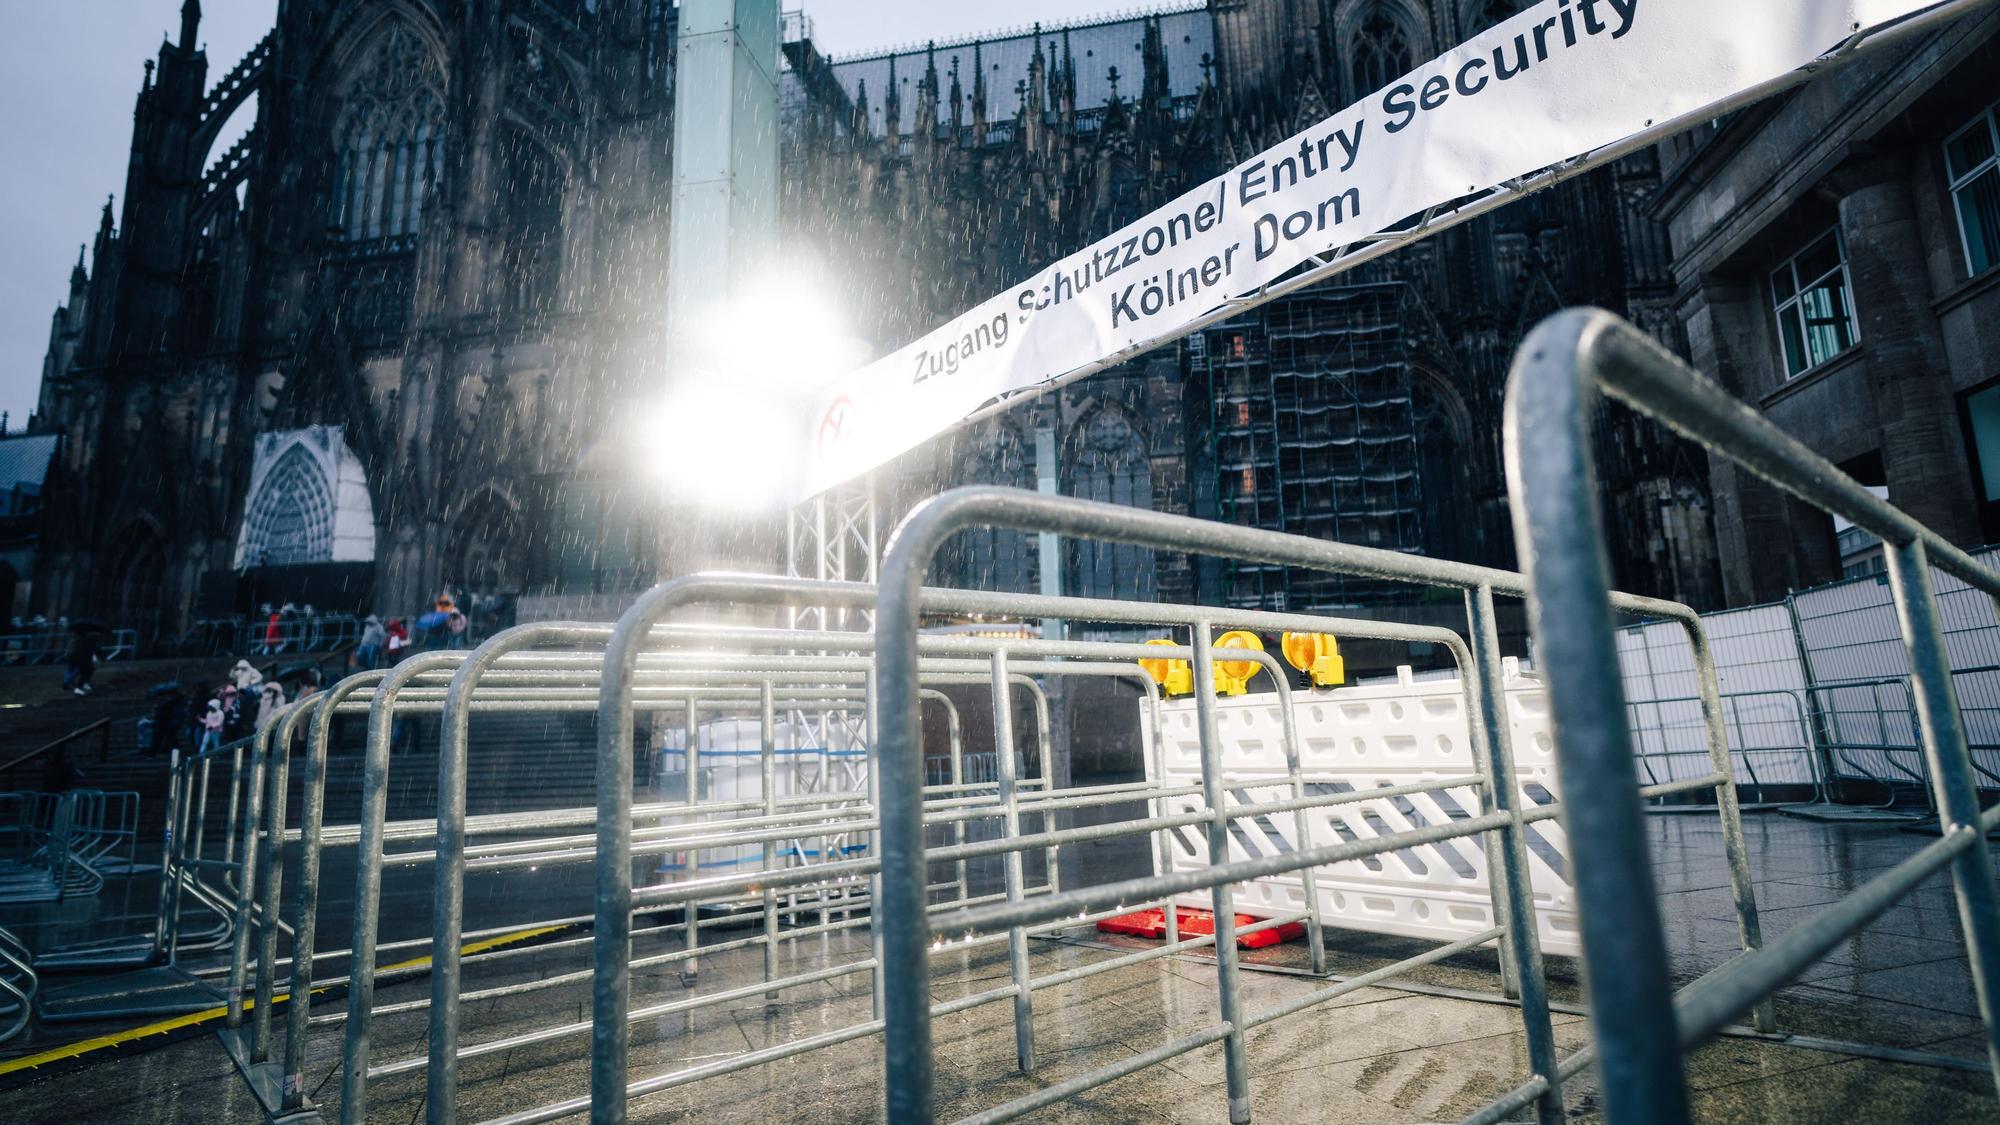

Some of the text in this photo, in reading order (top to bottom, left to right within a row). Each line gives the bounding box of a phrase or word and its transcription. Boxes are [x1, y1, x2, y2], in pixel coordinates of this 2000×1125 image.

[912, 0, 1638, 386] Zugang Schutzzone/ Entry Security
[1110, 186, 1361, 330] Kölner Dom
